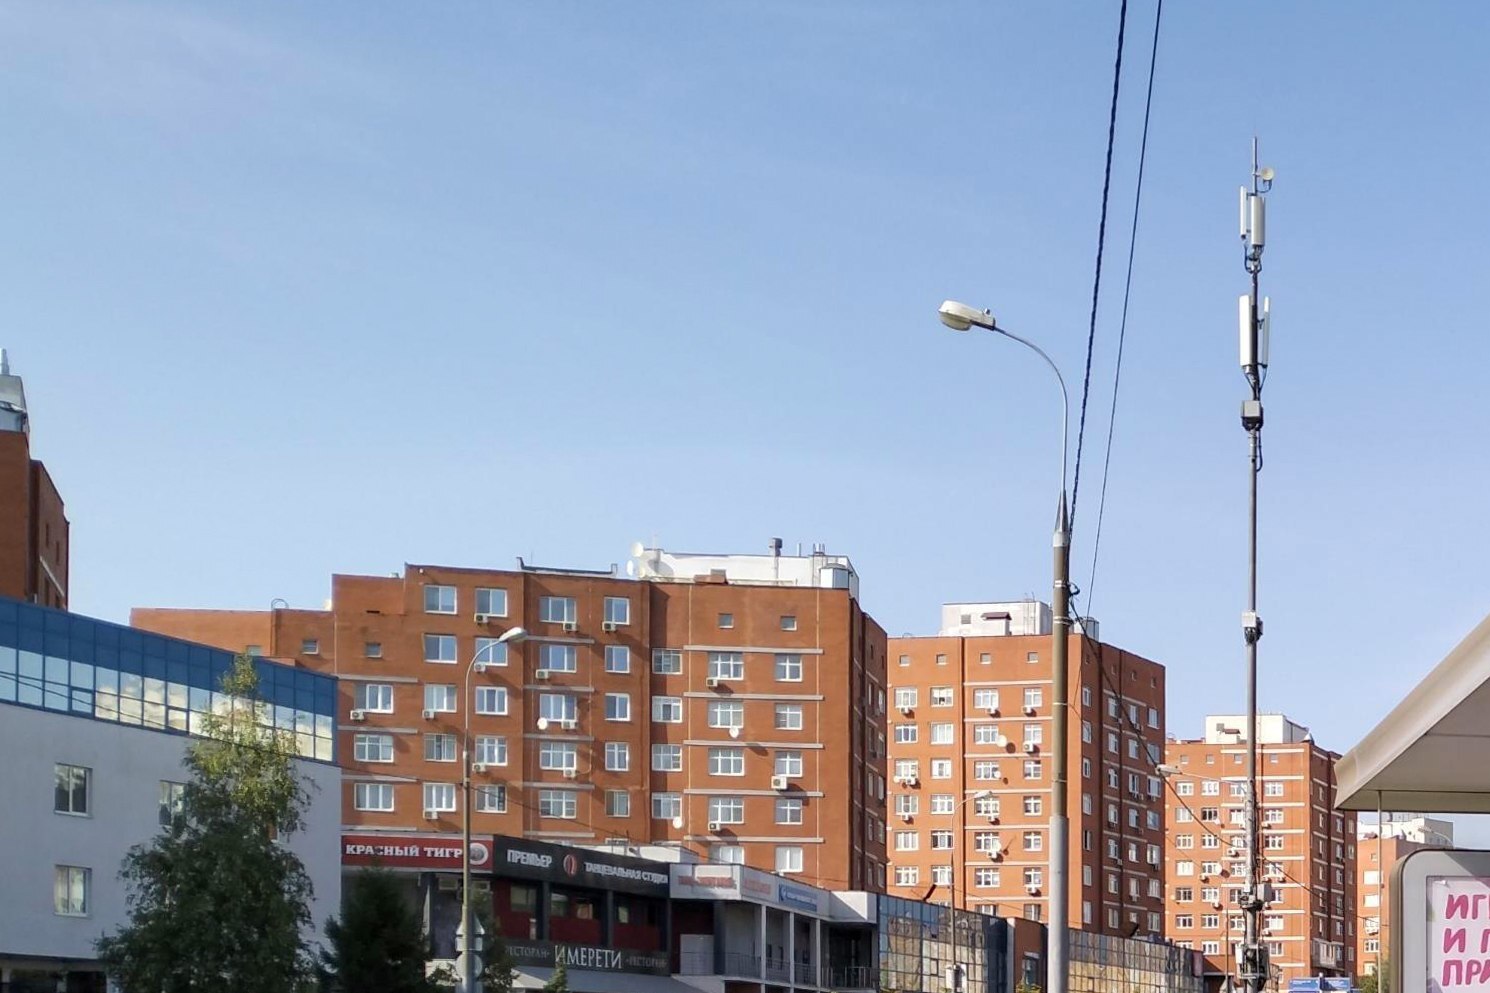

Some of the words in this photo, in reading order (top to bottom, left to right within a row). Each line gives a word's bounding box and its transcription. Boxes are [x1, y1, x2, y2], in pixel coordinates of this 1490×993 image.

[423, 847, 463, 859] ТИГР
[506, 849, 553, 868] ПРЕМЬЕР
[1443, 928, 1466, 953] И
[554, 945, 622, 969] ИМЕРЕТИ
